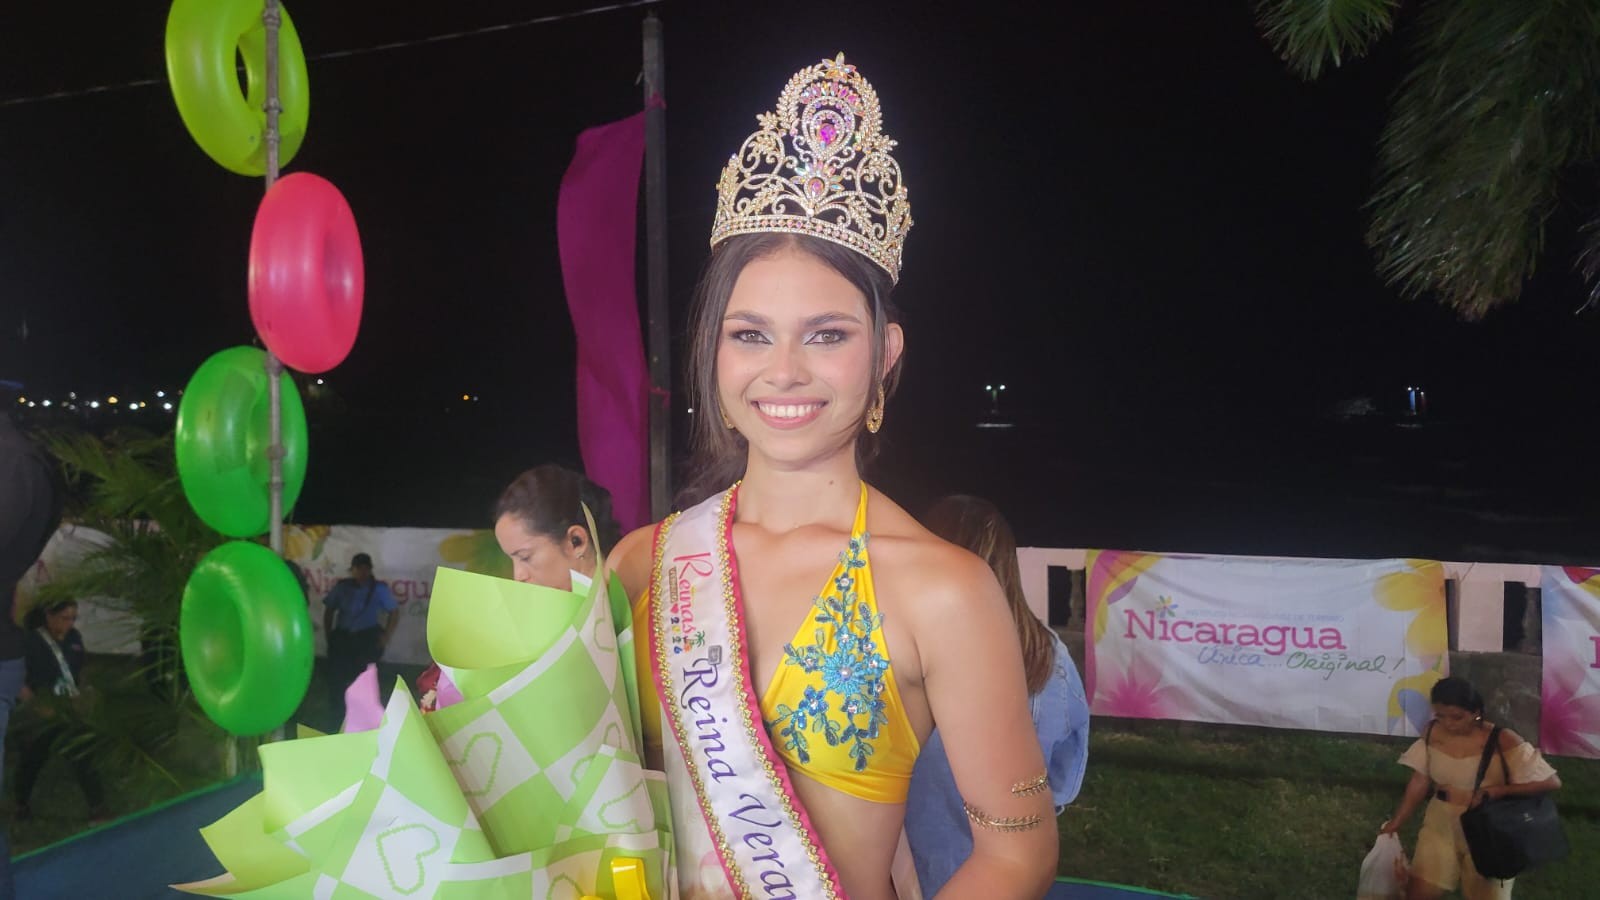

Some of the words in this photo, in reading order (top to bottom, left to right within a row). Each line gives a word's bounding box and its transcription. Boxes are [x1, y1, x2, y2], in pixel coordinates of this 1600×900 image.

[673, 552, 714, 634] Reinas
[1123, 609, 1347, 656] Nicaragua
[680, 658, 737, 783] Reina
